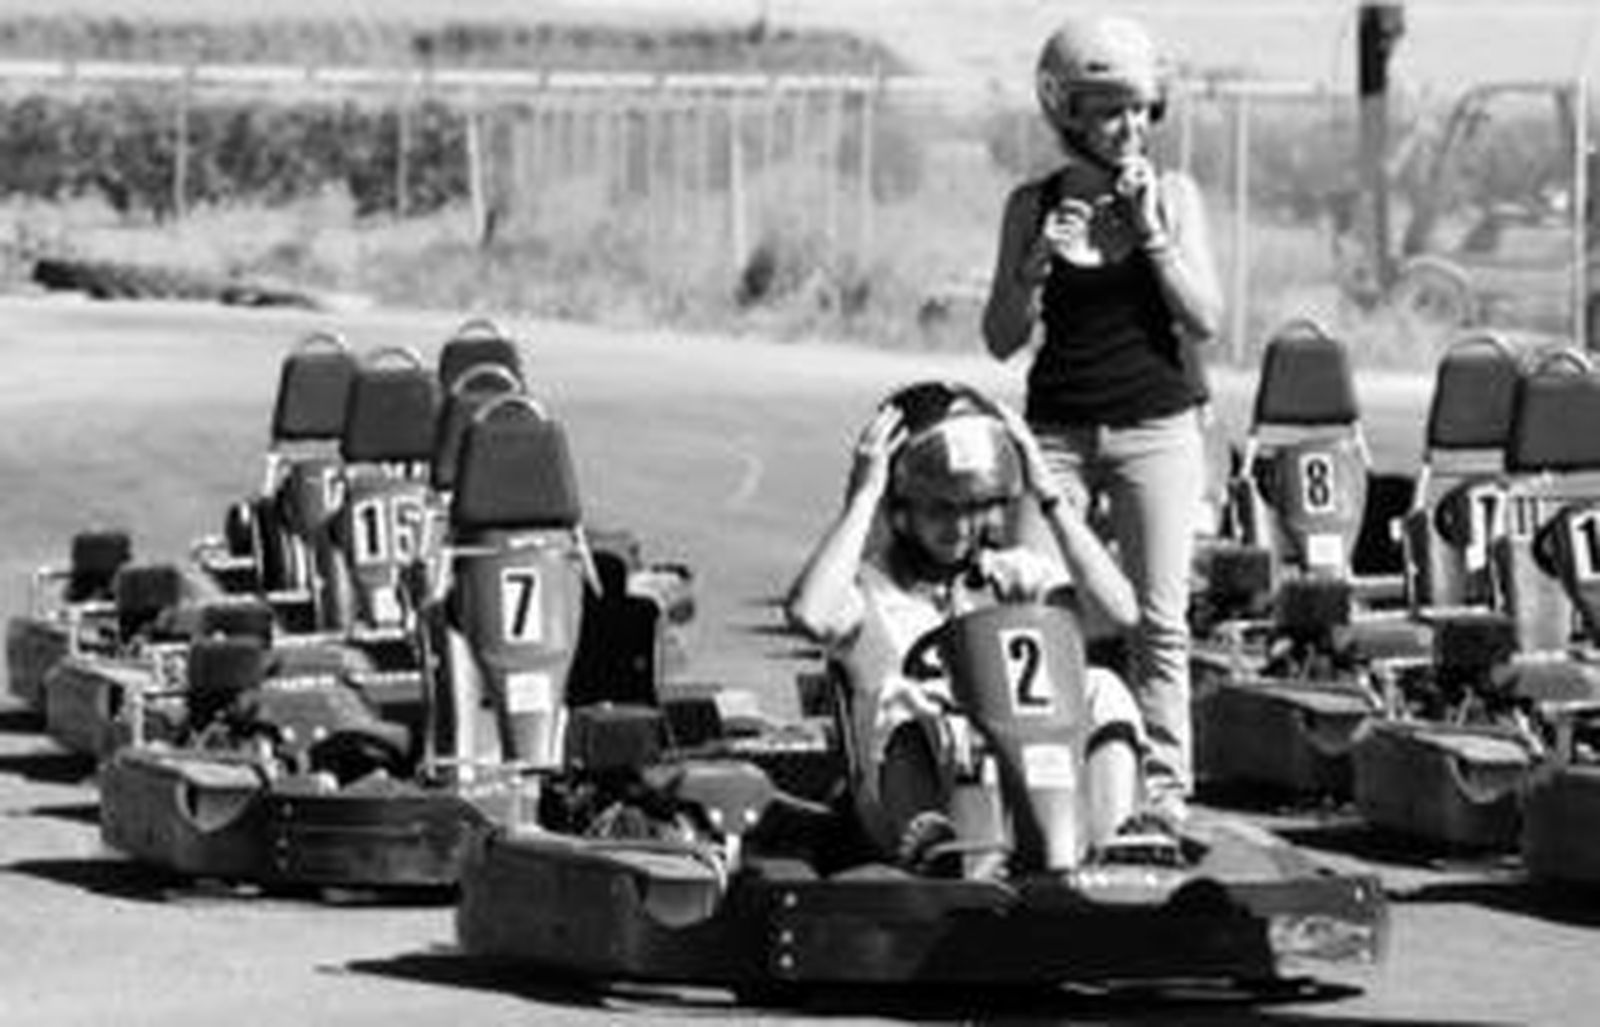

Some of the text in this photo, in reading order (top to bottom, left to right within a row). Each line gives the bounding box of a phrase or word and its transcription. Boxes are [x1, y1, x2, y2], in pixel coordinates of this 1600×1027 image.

[1305, 458, 1330, 506] 8
[505, 573, 536, 637] 7
[1008, 636, 1051, 706] 2
